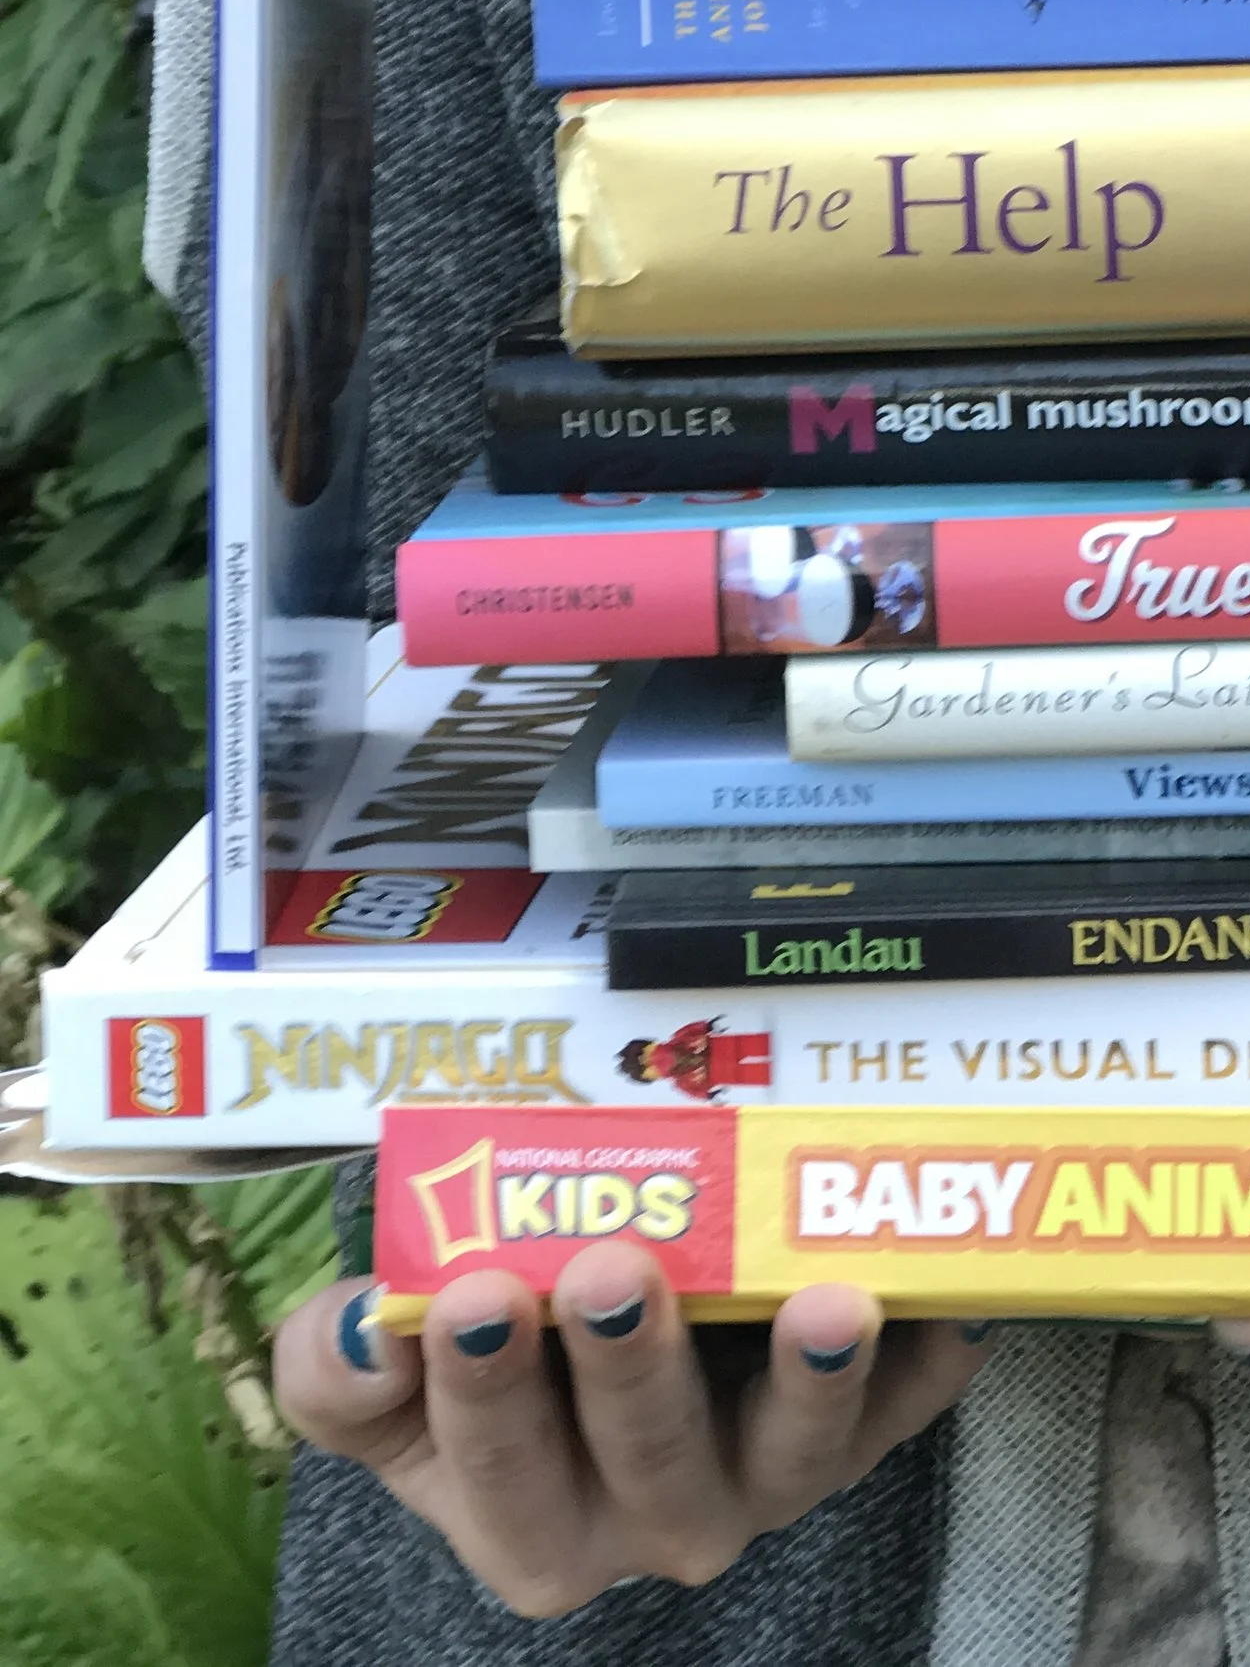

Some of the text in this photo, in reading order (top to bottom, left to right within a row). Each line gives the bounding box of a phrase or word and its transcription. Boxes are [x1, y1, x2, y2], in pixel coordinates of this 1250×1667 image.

[712, 138, 1166, 283] The Help
[561, 406, 735, 439] HUDLER
[789, 382, 1011, 454] Magical
[456, 583, 635, 617] CHRISTENSEN
[843, 654, 1130, 732] Gardener's
[712, 784, 874, 809] FREEMAN
[312, 872, 456, 938] LEGO
[741, 928, 926, 976] Landau
[226, 1018, 595, 1111] NINJAGO
[805, 1040, 928, 1083] THE
[951, 1039, 1177, 1082] VISUAL
[494, 1146, 702, 1171] NATIONAL GEOGRAPHIC
[496, 1172, 698, 1244] KIDS
[800, 1161, 1034, 1237] BABY
